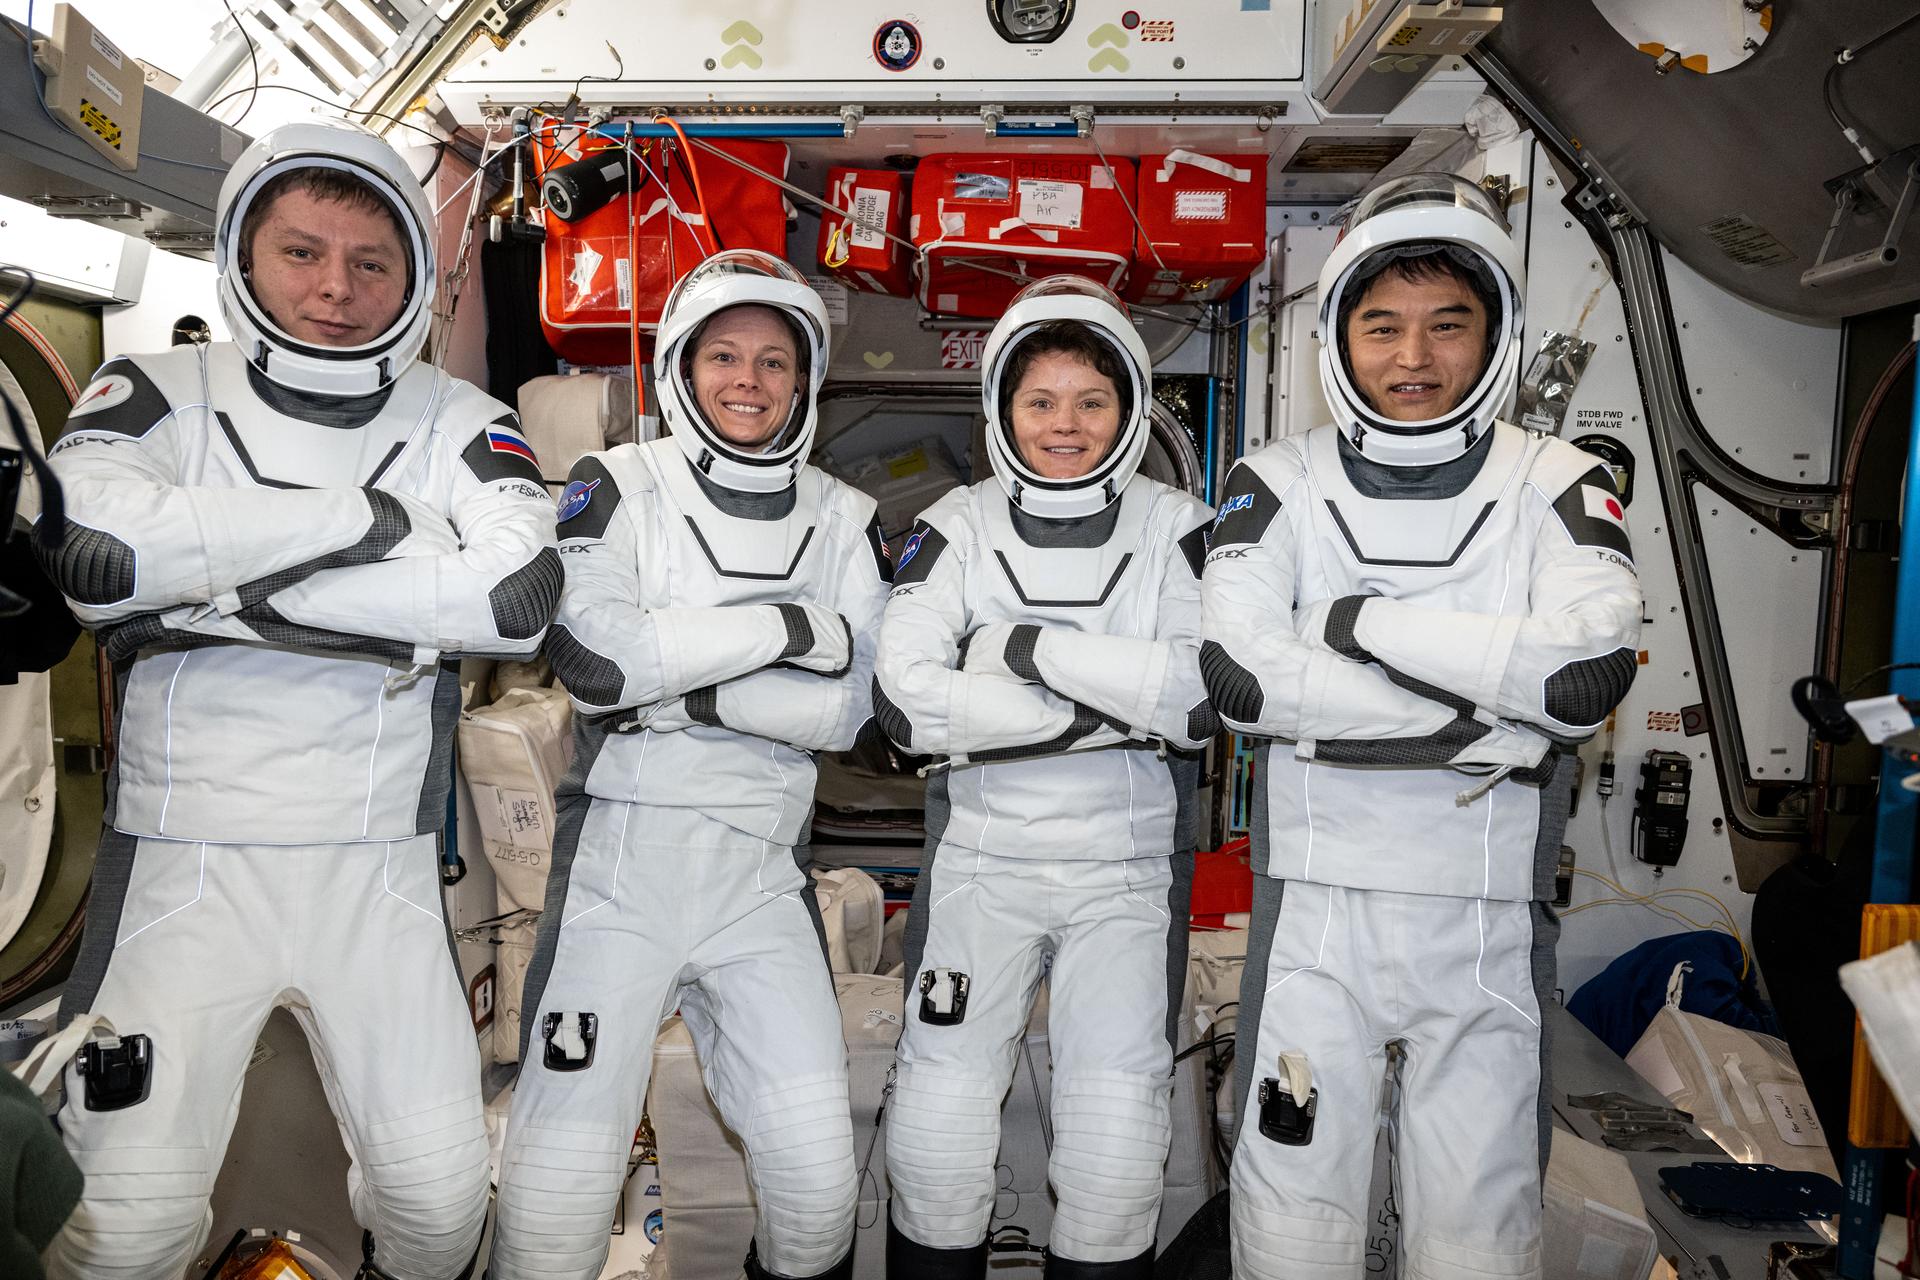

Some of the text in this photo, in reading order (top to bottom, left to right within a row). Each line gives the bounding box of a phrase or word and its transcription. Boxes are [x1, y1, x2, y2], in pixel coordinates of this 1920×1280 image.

[875, 210, 886, 228] BAG
[950, 340, 983, 359] EXIT
[1577, 410, 1624, 419] STDB FWD
[1595, 421, 1623, 429] VALVE
